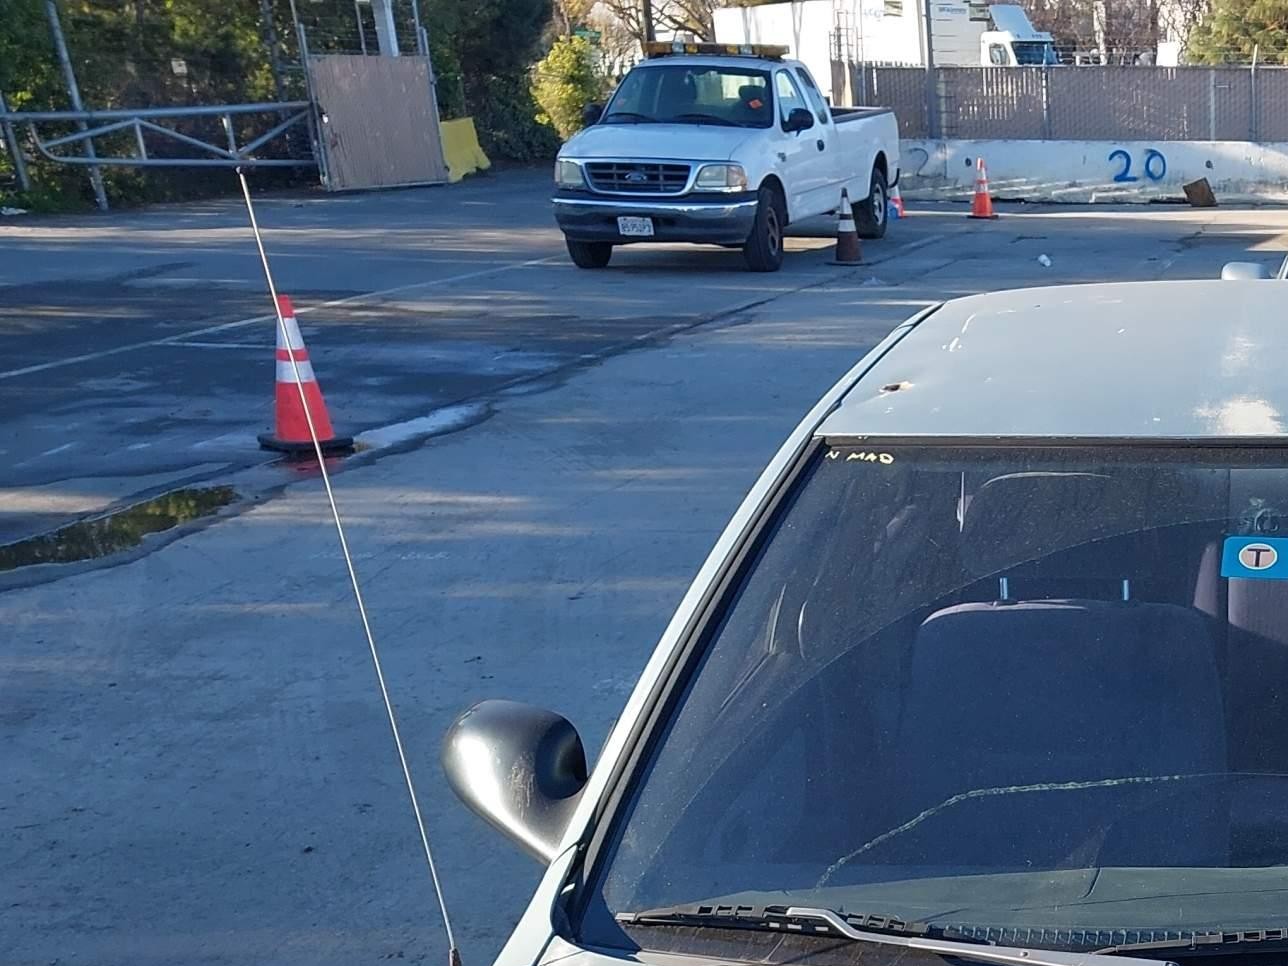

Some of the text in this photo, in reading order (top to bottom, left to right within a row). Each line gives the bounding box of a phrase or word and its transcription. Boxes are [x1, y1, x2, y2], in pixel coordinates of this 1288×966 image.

[1108, 149, 1166, 182] 20
[846, 451, 894, 464] MAD
[1247, 549, 1270, 567] T
